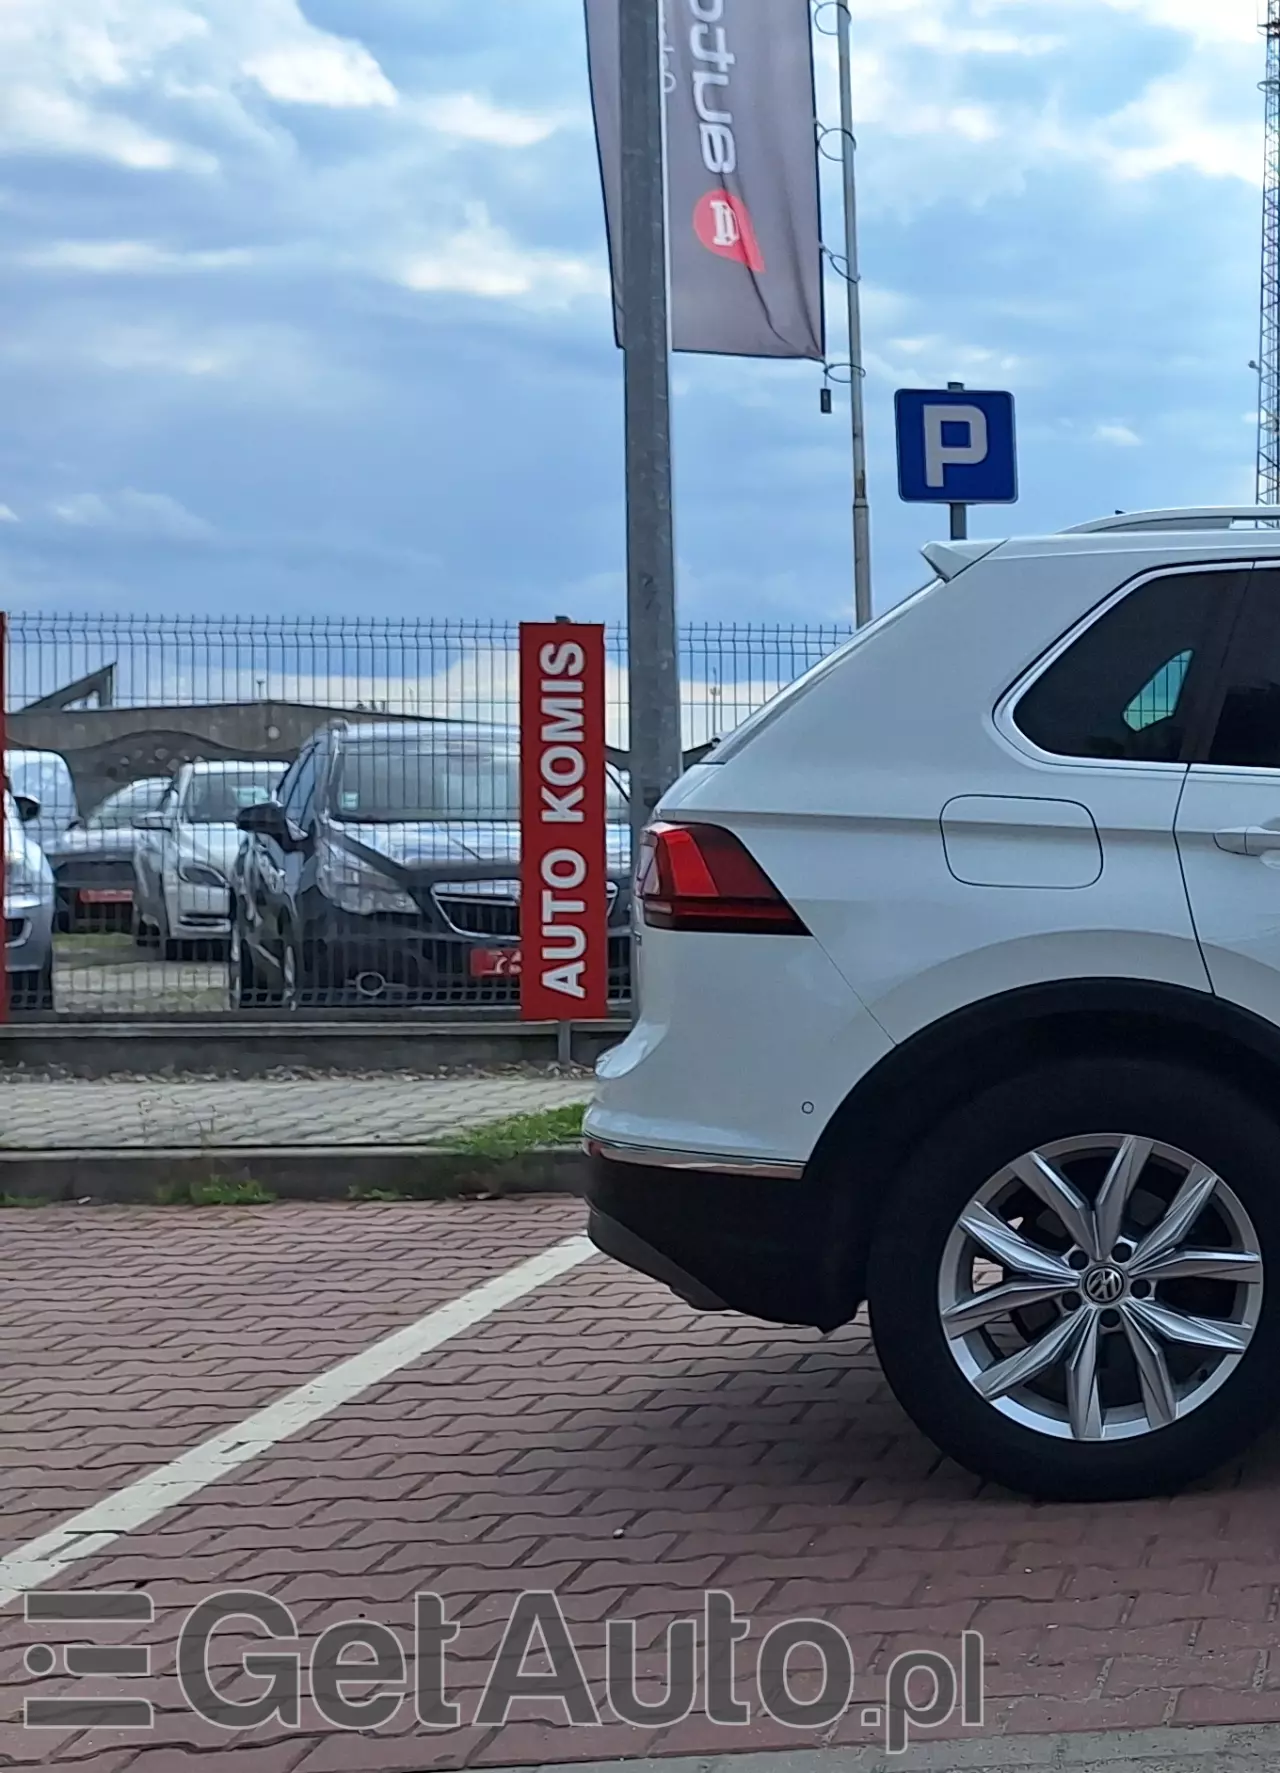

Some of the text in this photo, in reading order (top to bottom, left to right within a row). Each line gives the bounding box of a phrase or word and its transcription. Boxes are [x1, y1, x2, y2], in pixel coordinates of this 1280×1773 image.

[923, 404, 988, 488] P
[540, 640, 587, 999] AUTO KOMIS
